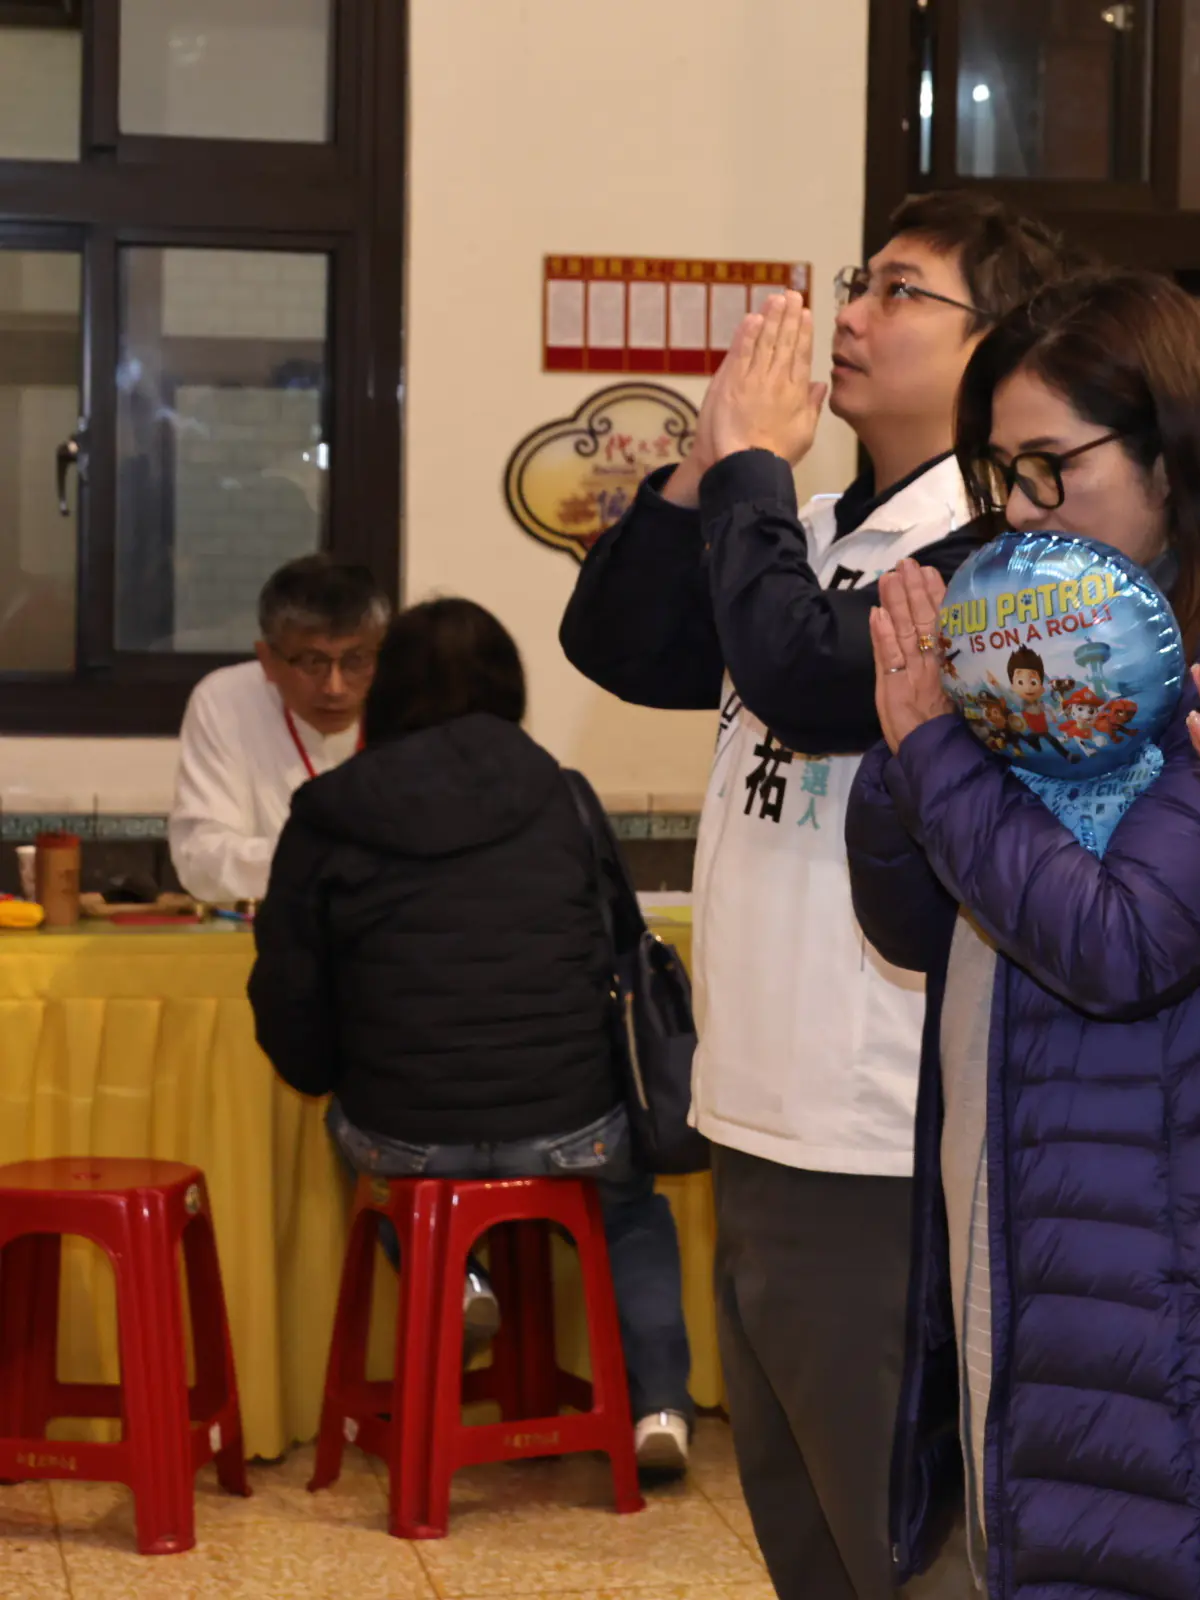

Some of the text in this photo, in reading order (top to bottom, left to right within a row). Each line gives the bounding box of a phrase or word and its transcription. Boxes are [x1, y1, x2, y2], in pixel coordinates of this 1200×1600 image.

[996, 573, 1120, 628] PATROL
[969, 602, 1113, 653] IS ON A ROLL!
